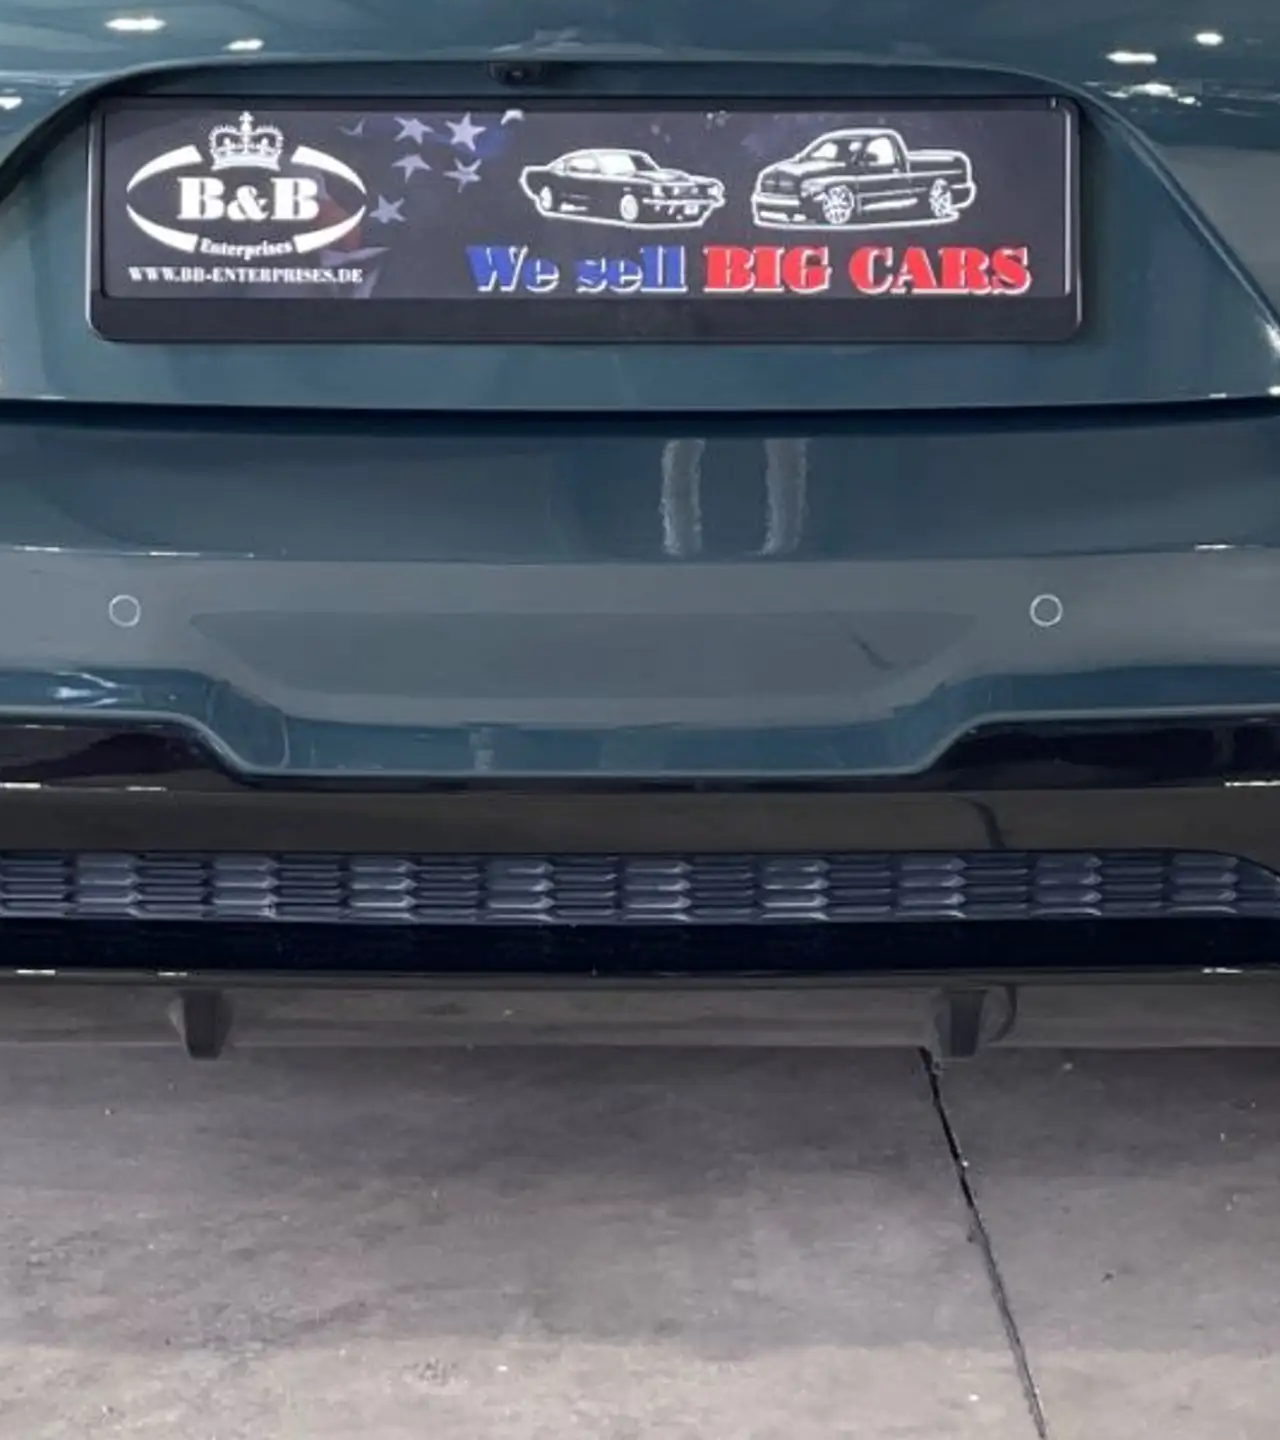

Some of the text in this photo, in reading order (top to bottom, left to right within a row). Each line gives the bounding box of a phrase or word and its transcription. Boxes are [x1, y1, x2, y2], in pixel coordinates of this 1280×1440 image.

[176, 176, 320, 222] B&B
[200, 236, 294, 261] Enterprises
[465, 244, 1034, 295] We sell BIG CARS
